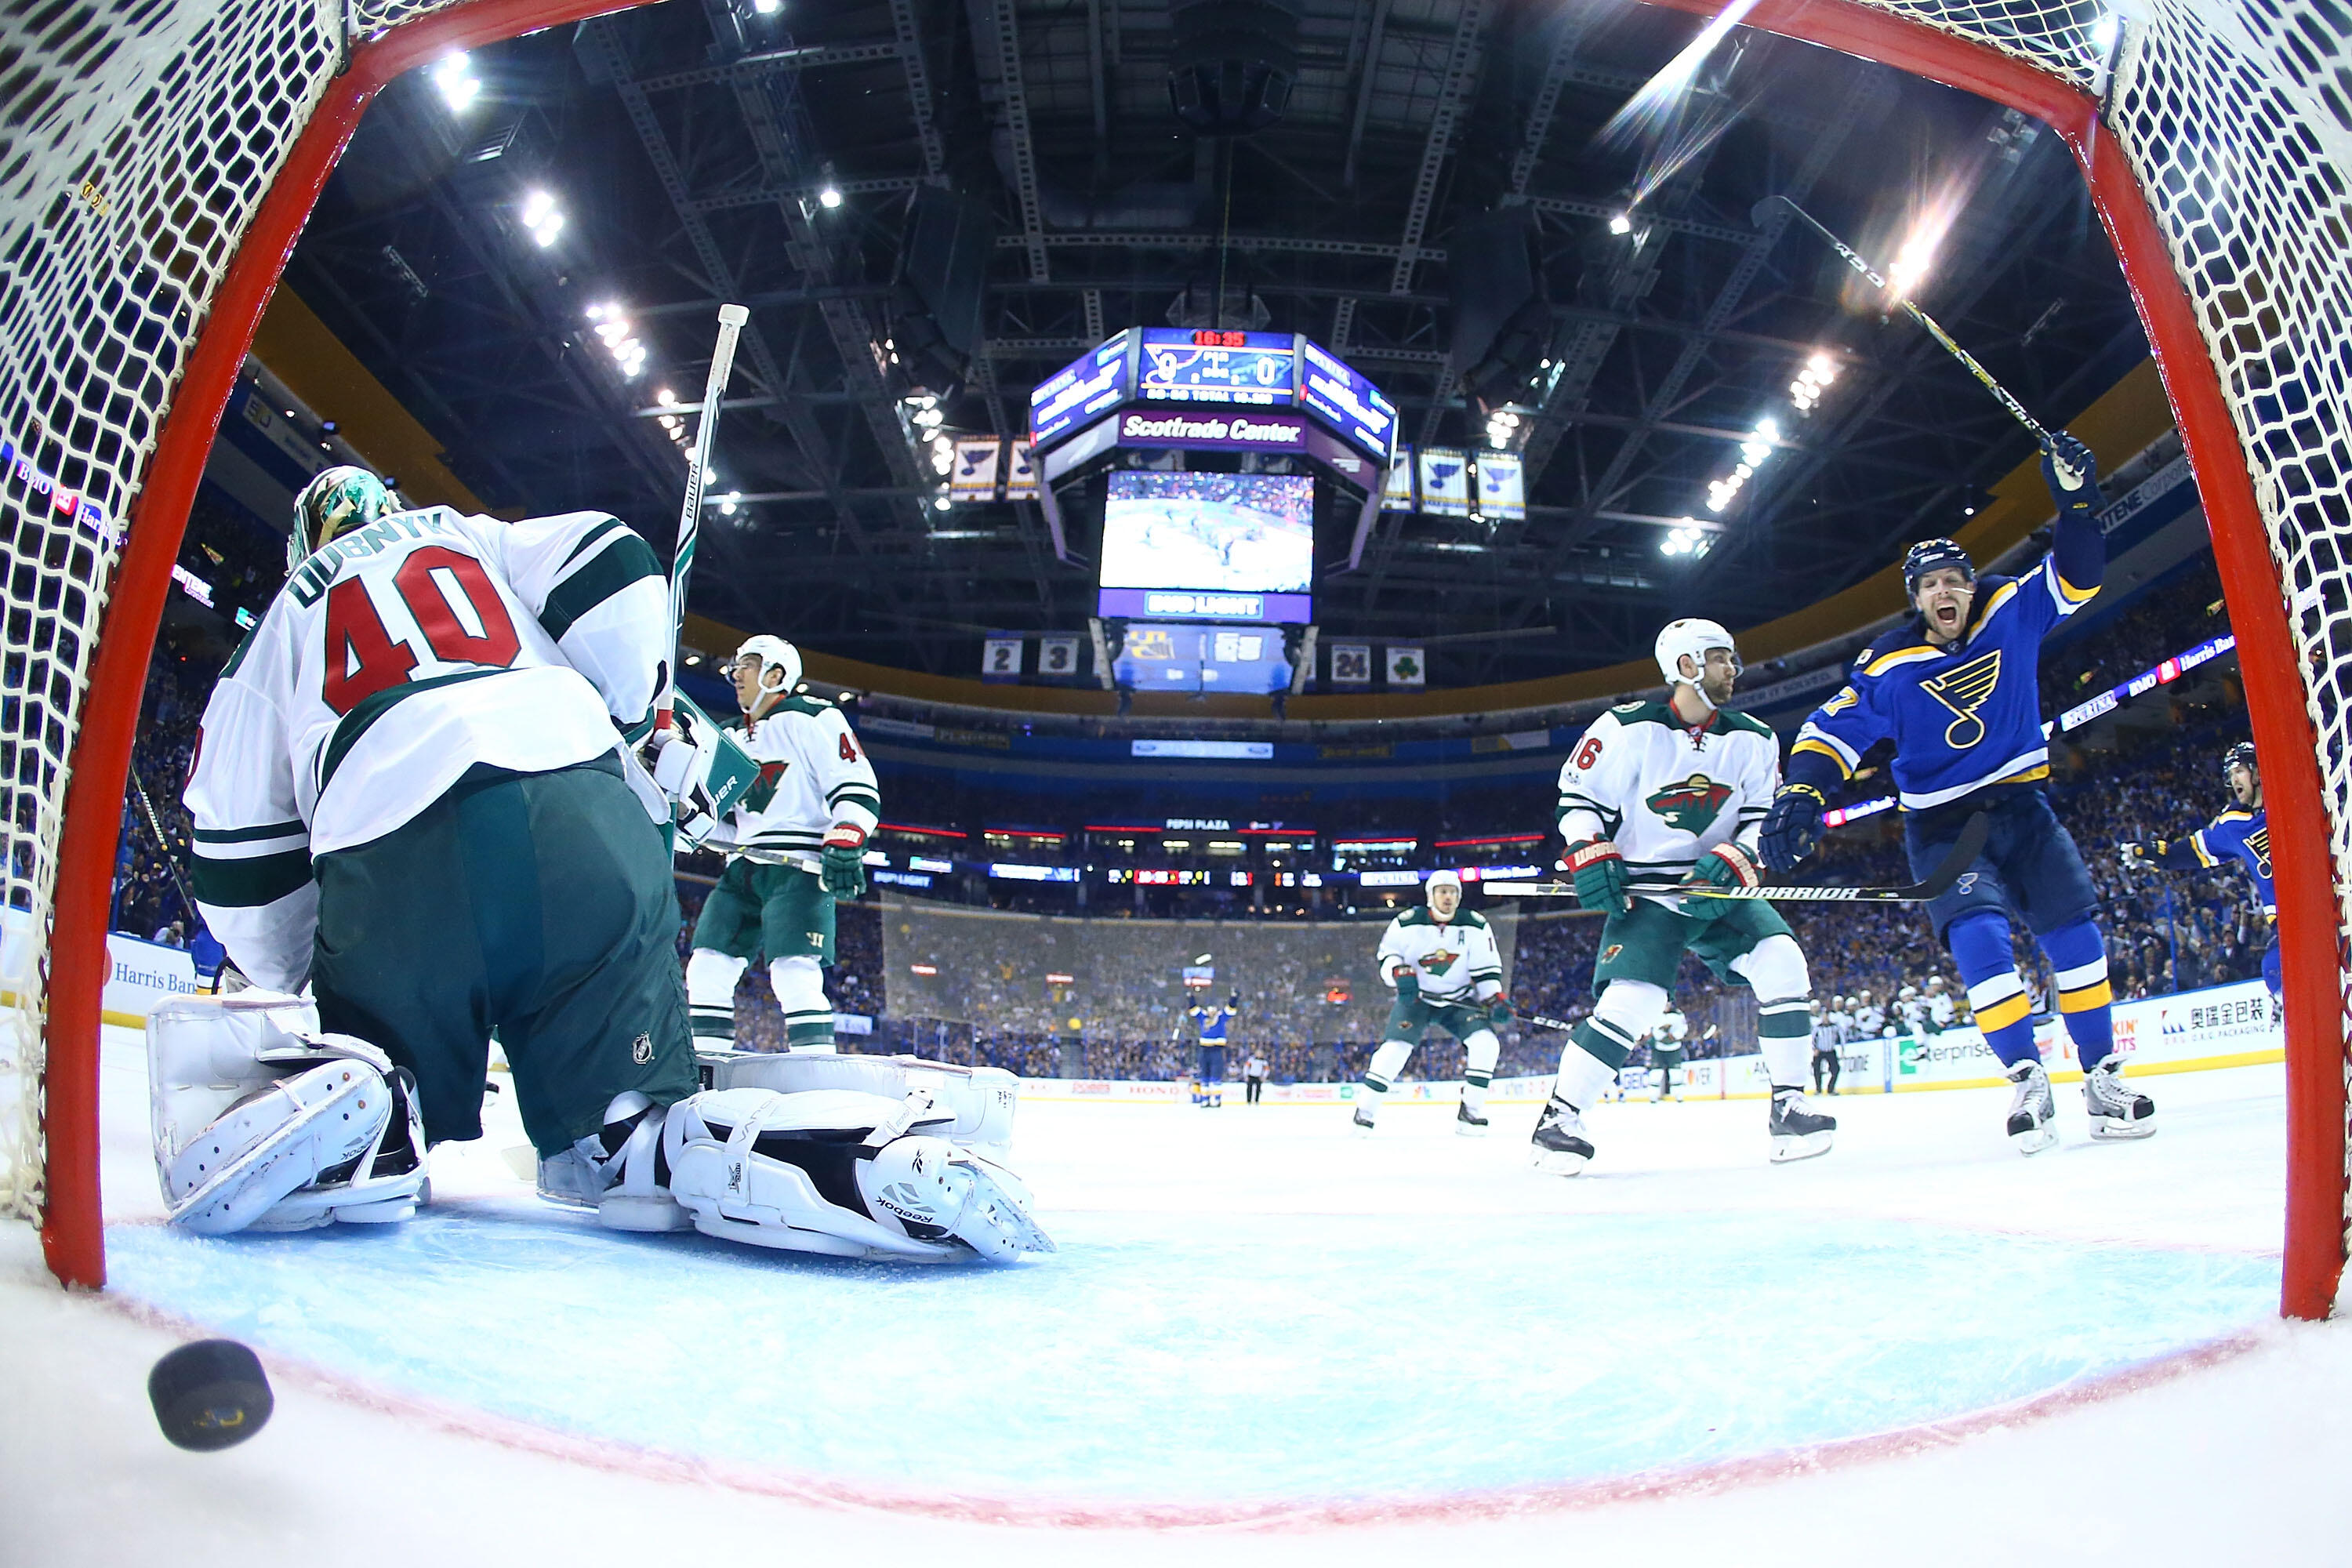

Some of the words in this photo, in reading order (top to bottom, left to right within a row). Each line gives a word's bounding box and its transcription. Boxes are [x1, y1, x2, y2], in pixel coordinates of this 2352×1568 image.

[1195, 331, 1245, 347] 16:35
[1158, 352, 1178, 380] 0
[1257, 357, 1276, 385] 0
[1123, 415, 1229, 439] Scottrade
[1229, 419, 1301, 442] Center
[287, 512, 459, 609] DUBNYK
[1196, 596, 1260, 615] LIGHT
[321, 545, 522, 719] 40
[994, 648, 1011, 671] 2
[1049, 646, 1069, 670] 3
[1337, 653, 1367, 678] 24
[1166, 818, 1194, 830] PEPSI
[1195, 819, 1230, 831] PLAZA
[1729, 886, 1861, 900] WARRIOR
[115, 962, 165, 989] Harris
[168, 973, 196, 995] Ban
[1903, 1039, 1995, 1067] eterprise
[1130, 1085, 1184, 1095] HOND
[876, 1196, 934, 1224] Reebok
